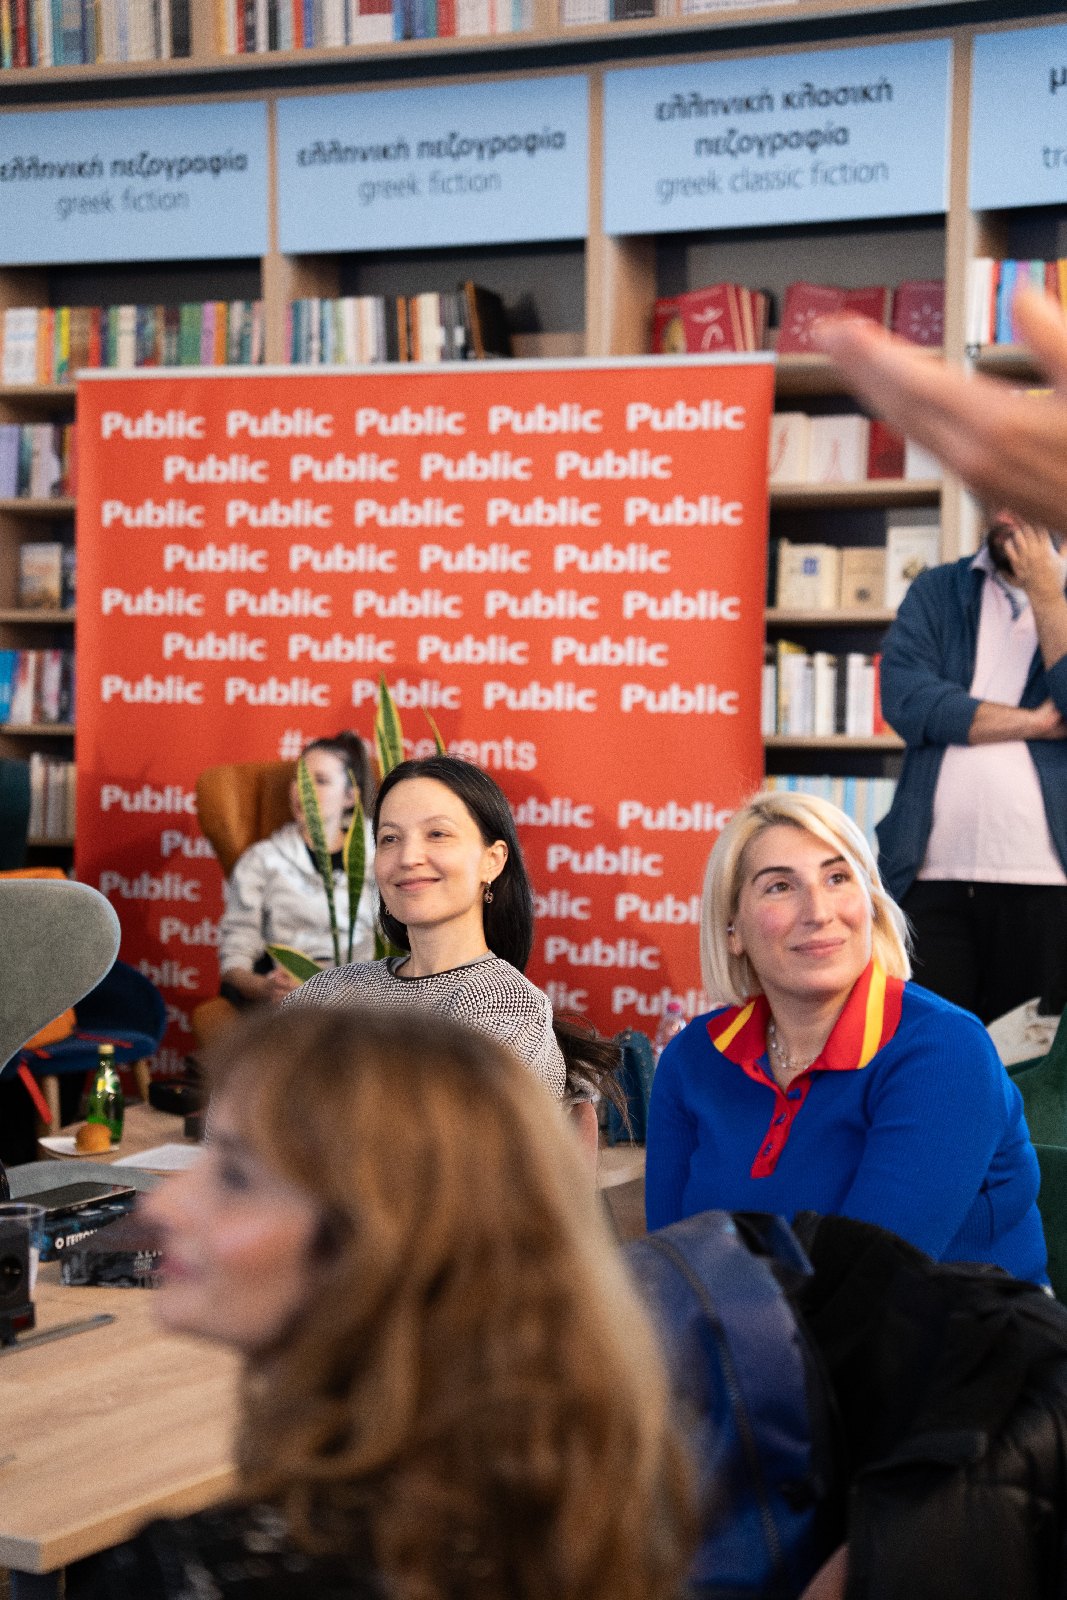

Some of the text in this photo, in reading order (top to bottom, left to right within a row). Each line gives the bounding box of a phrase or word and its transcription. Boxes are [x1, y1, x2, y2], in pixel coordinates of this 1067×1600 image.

[781, 76, 894, 110] κλασική
[416, 127, 567, 161] πεζογραφία
[694, 121, 850, 158] πεζογραφία
[110, 149, 248, 181] πεζογραφία
[656, 158, 889, 205] greek classic fiction
[56, 185, 189, 221] greek fiction
[357, 168, 501, 206] greek fiction
[102, 400, 744, 439] Public Public Public Public Public
[164, 449, 671, 483] Public Public Public Public
[102, 496, 741, 527] Public Public Public Public Public
[164, 543, 669, 573] Public Public Public Public
[102, 587, 738, 620] Public Public Public Public Public
[163, 632, 667, 666] Public Public Public Public
[101, 675, 202, 704] Public
[226, 677, 329, 706] Public
[484, 682, 596, 712] Public
[621, 683, 736, 714] Public
[101, 784, 198, 815] Public
[514, 798, 594, 828] ublic
[547, 844, 664, 877] Public
[100, 871, 701, 924] Public blic Publ
[160, 917, 660, 970] Pub Public
